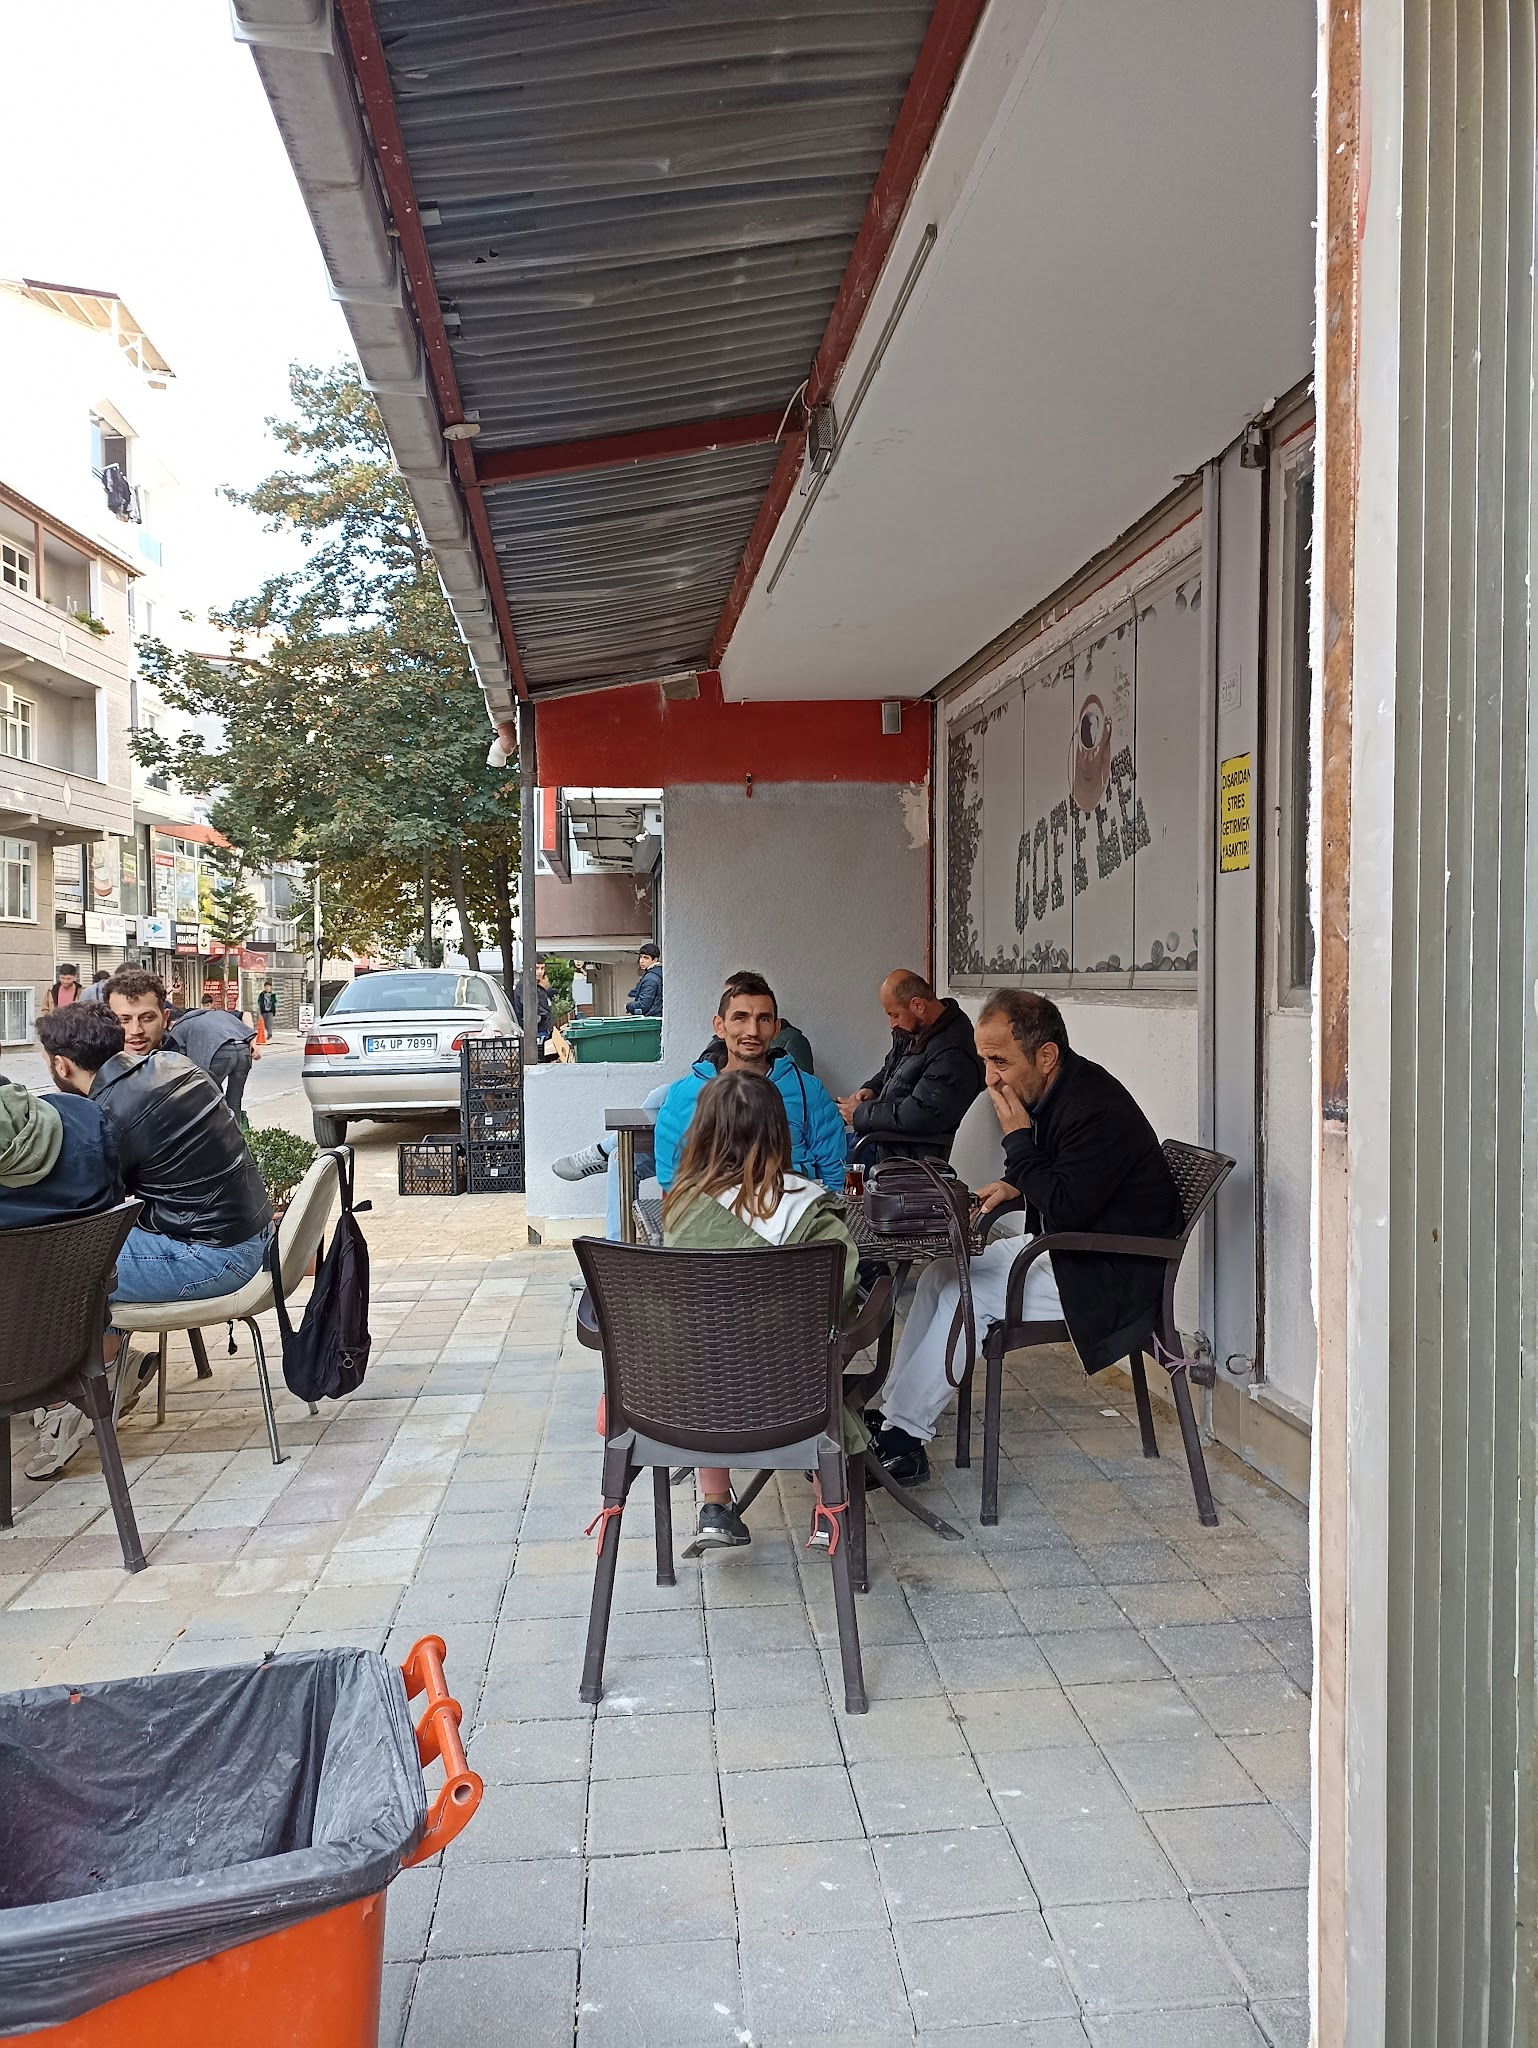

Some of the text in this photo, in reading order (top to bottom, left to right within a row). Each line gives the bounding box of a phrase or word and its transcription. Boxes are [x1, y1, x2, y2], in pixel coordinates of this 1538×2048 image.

[1227, 793, 1245, 812] STRES
[373, 1038, 433, 1050] 34 UP 7899
